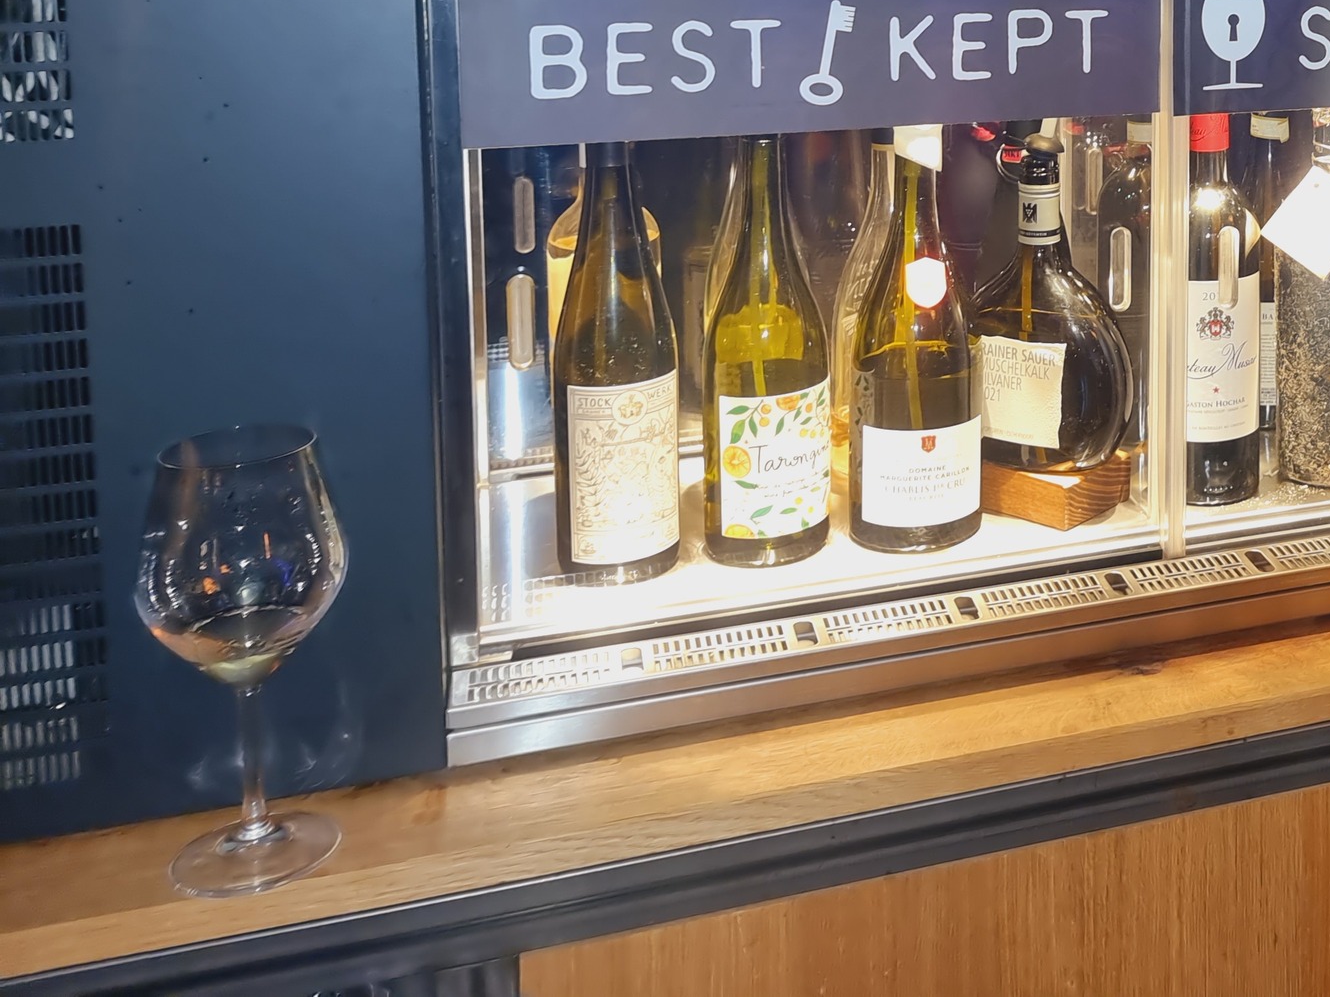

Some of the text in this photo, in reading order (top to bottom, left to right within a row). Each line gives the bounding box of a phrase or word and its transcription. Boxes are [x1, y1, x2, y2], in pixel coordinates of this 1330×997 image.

[529, 19, 782, 100] BEST
[889, 9, 1109, 82] KEPT
[981, 342, 1056, 367] RAINER SAUER
[984, 372, 1022, 391] ILVANER
[577, 385, 672, 408] STOCK WERK
[984, 386, 1001, 402] 021
[909, 465, 947, 474] DOMAINE
